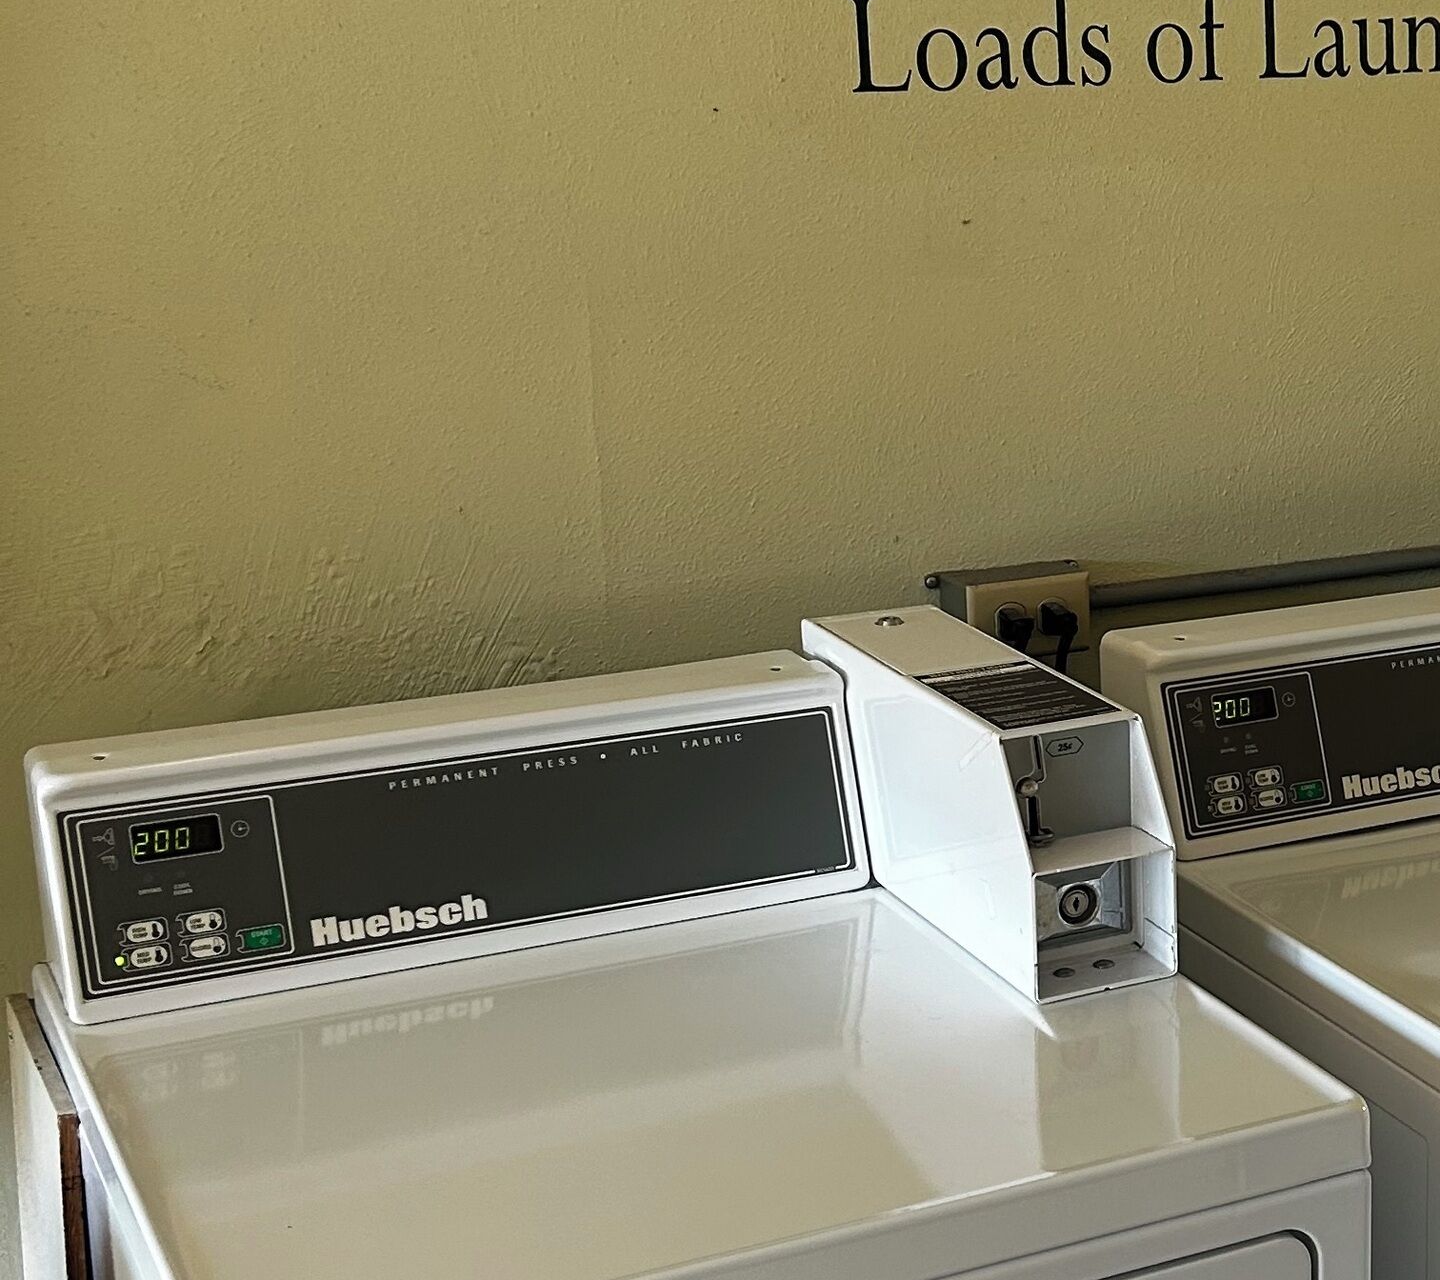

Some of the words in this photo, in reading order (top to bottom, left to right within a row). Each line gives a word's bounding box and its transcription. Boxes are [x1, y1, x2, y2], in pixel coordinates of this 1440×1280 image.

[388, 767, 498, 791] PERMANENT
[522, 756, 579, 772] PRESS
[630, 745, 660, 757] ALL
[681, 733, 744, 750] FABRIC
[134, 827, 190, 856] 200
[310, 894, 489, 947] Huebsch
